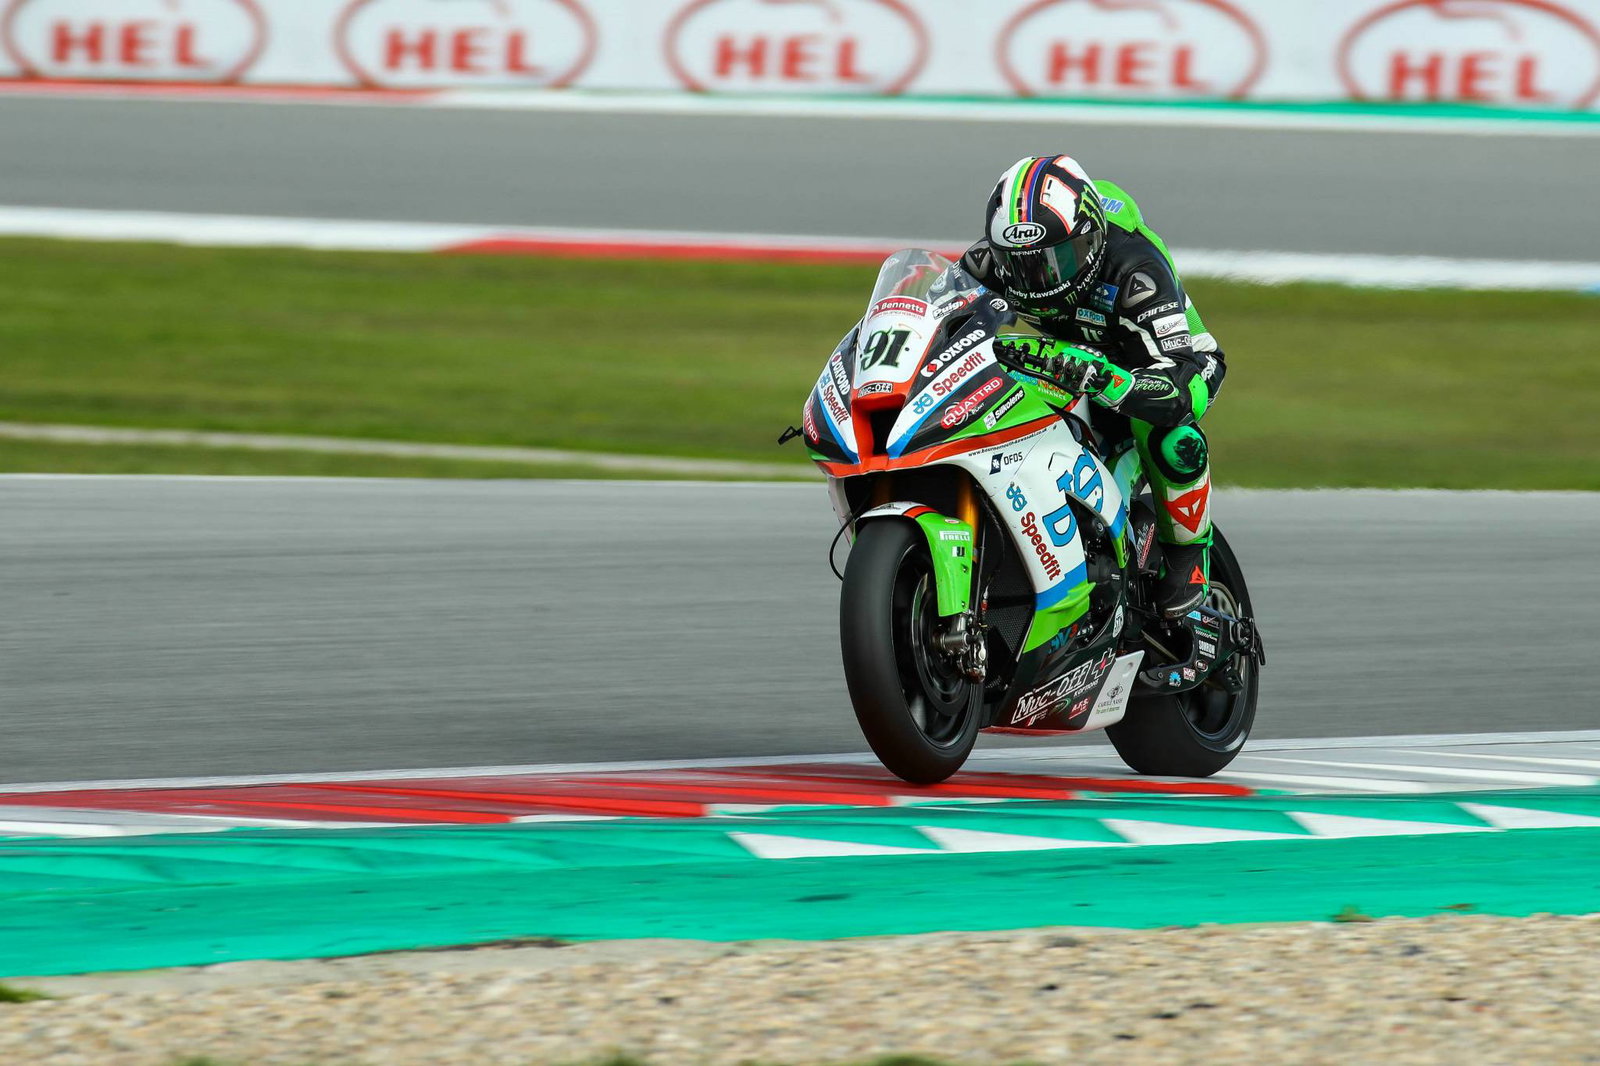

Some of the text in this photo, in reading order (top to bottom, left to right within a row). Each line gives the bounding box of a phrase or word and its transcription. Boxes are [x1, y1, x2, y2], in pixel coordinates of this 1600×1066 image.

[51, 21, 208, 68] HEL
[382, 28, 540, 74] HEL
[713, 35, 872, 82] HEL
[1046, 40, 1203, 89] HEL
[1387, 50, 1550, 102] HEL
[1006, 226, 1039, 239] Arai
[1011, 248, 1042, 256] INFINITY
[881, 302, 924, 313] Bennetts
[1030, 280, 1071, 299] Kawasaki
[1137, 300, 1179, 323] DAINESE
[860, 326, 912, 374] 91
[938, 329, 986, 362] OXFORD
[833, 360, 851, 396] OXFORD
[932, 351, 986, 397] Speedfit
[823, 384, 849, 426] Speedfit
[943, 379, 1001, 426] QUATTRO
[1003, 451, 1023, 466] DFDS
[939, 530, 970, 541] PIRELLI
[1020, 511, 1062, 581] Speedfit
